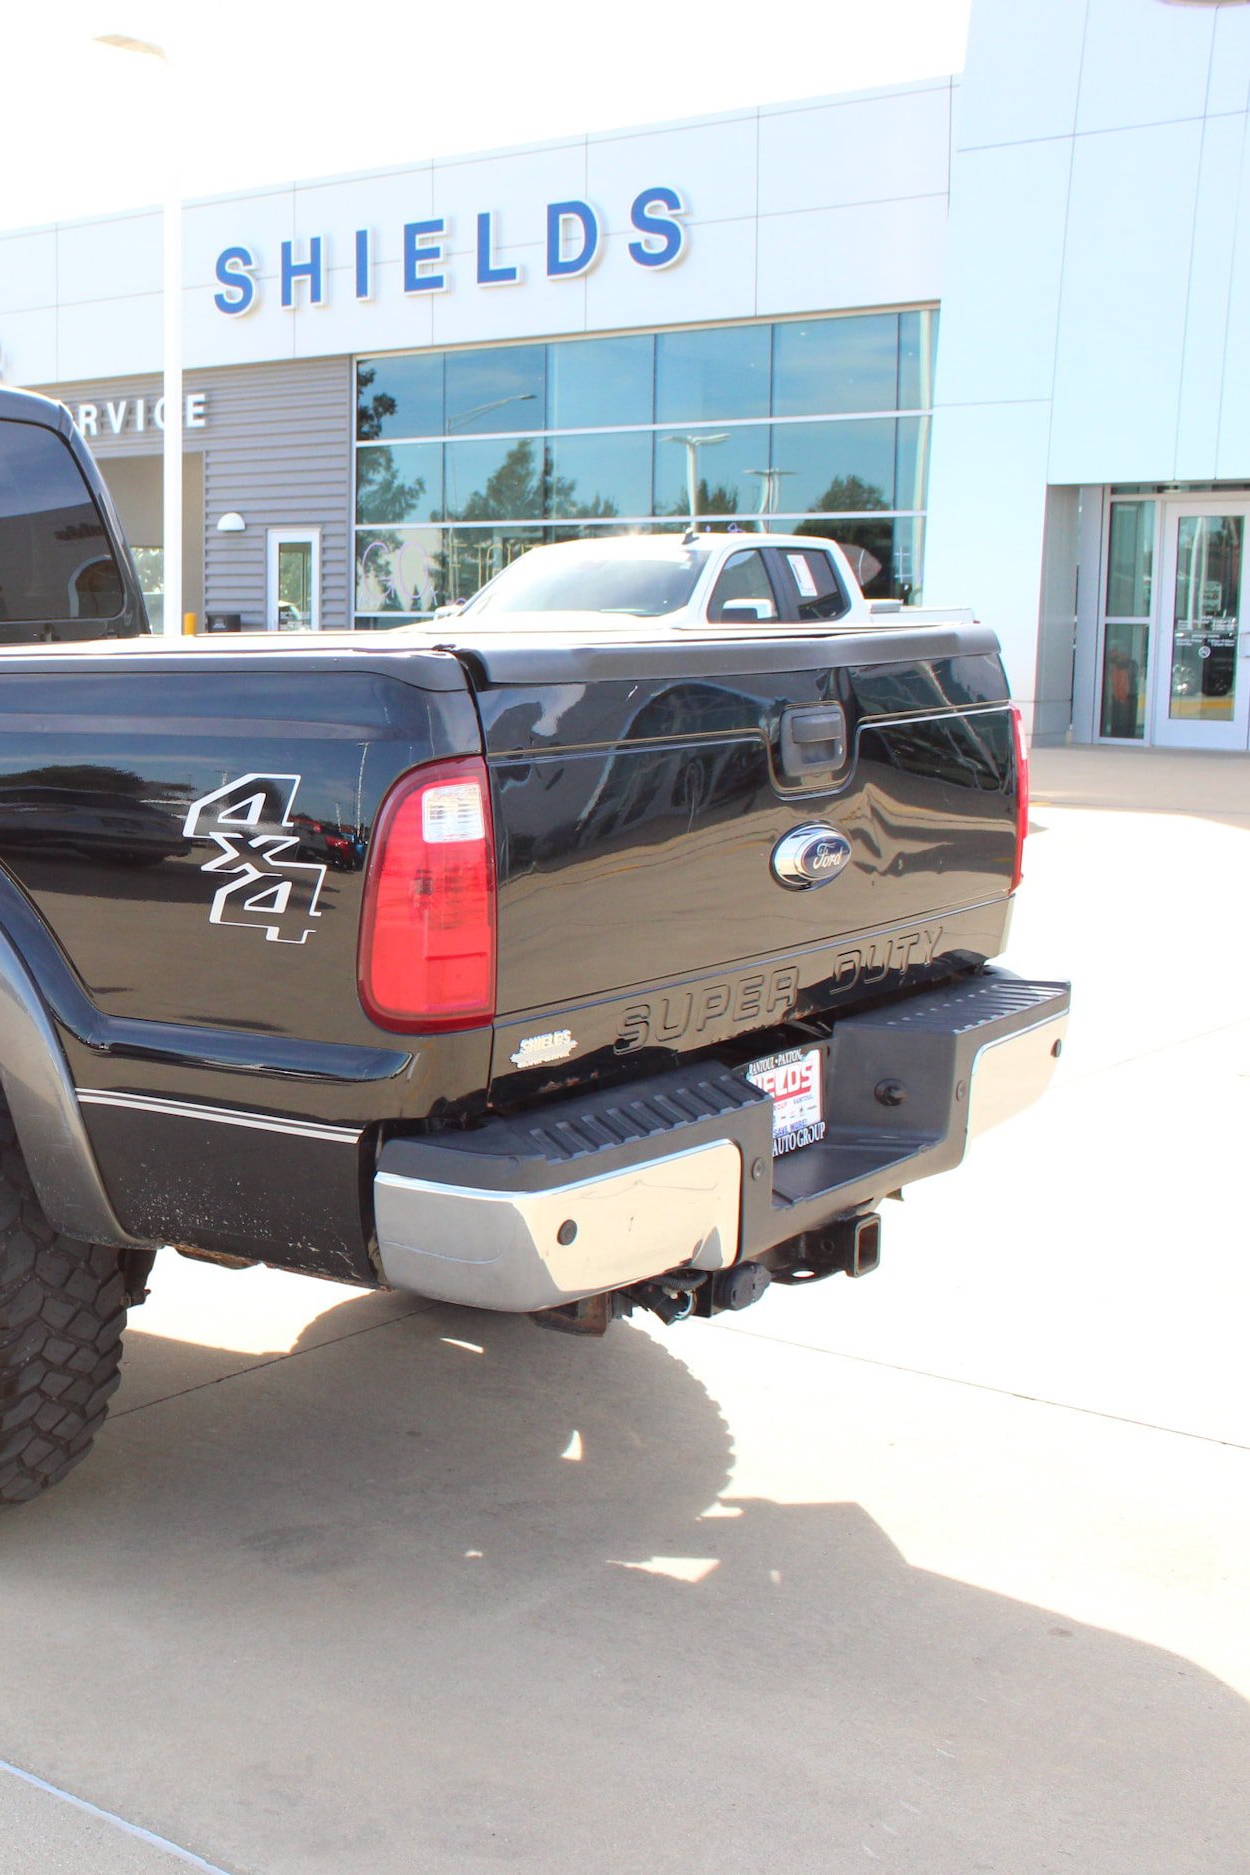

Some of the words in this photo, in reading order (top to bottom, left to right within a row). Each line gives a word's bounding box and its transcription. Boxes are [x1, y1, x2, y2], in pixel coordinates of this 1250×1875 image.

[212, 185, 688, 318] SHIELDS
[73, 393, 207, 436] RVIE
[812, 842, 843, 870] Ford
[613, 965, 799, 1055] SUPER
[829, 926, 944, 995] DUTY
